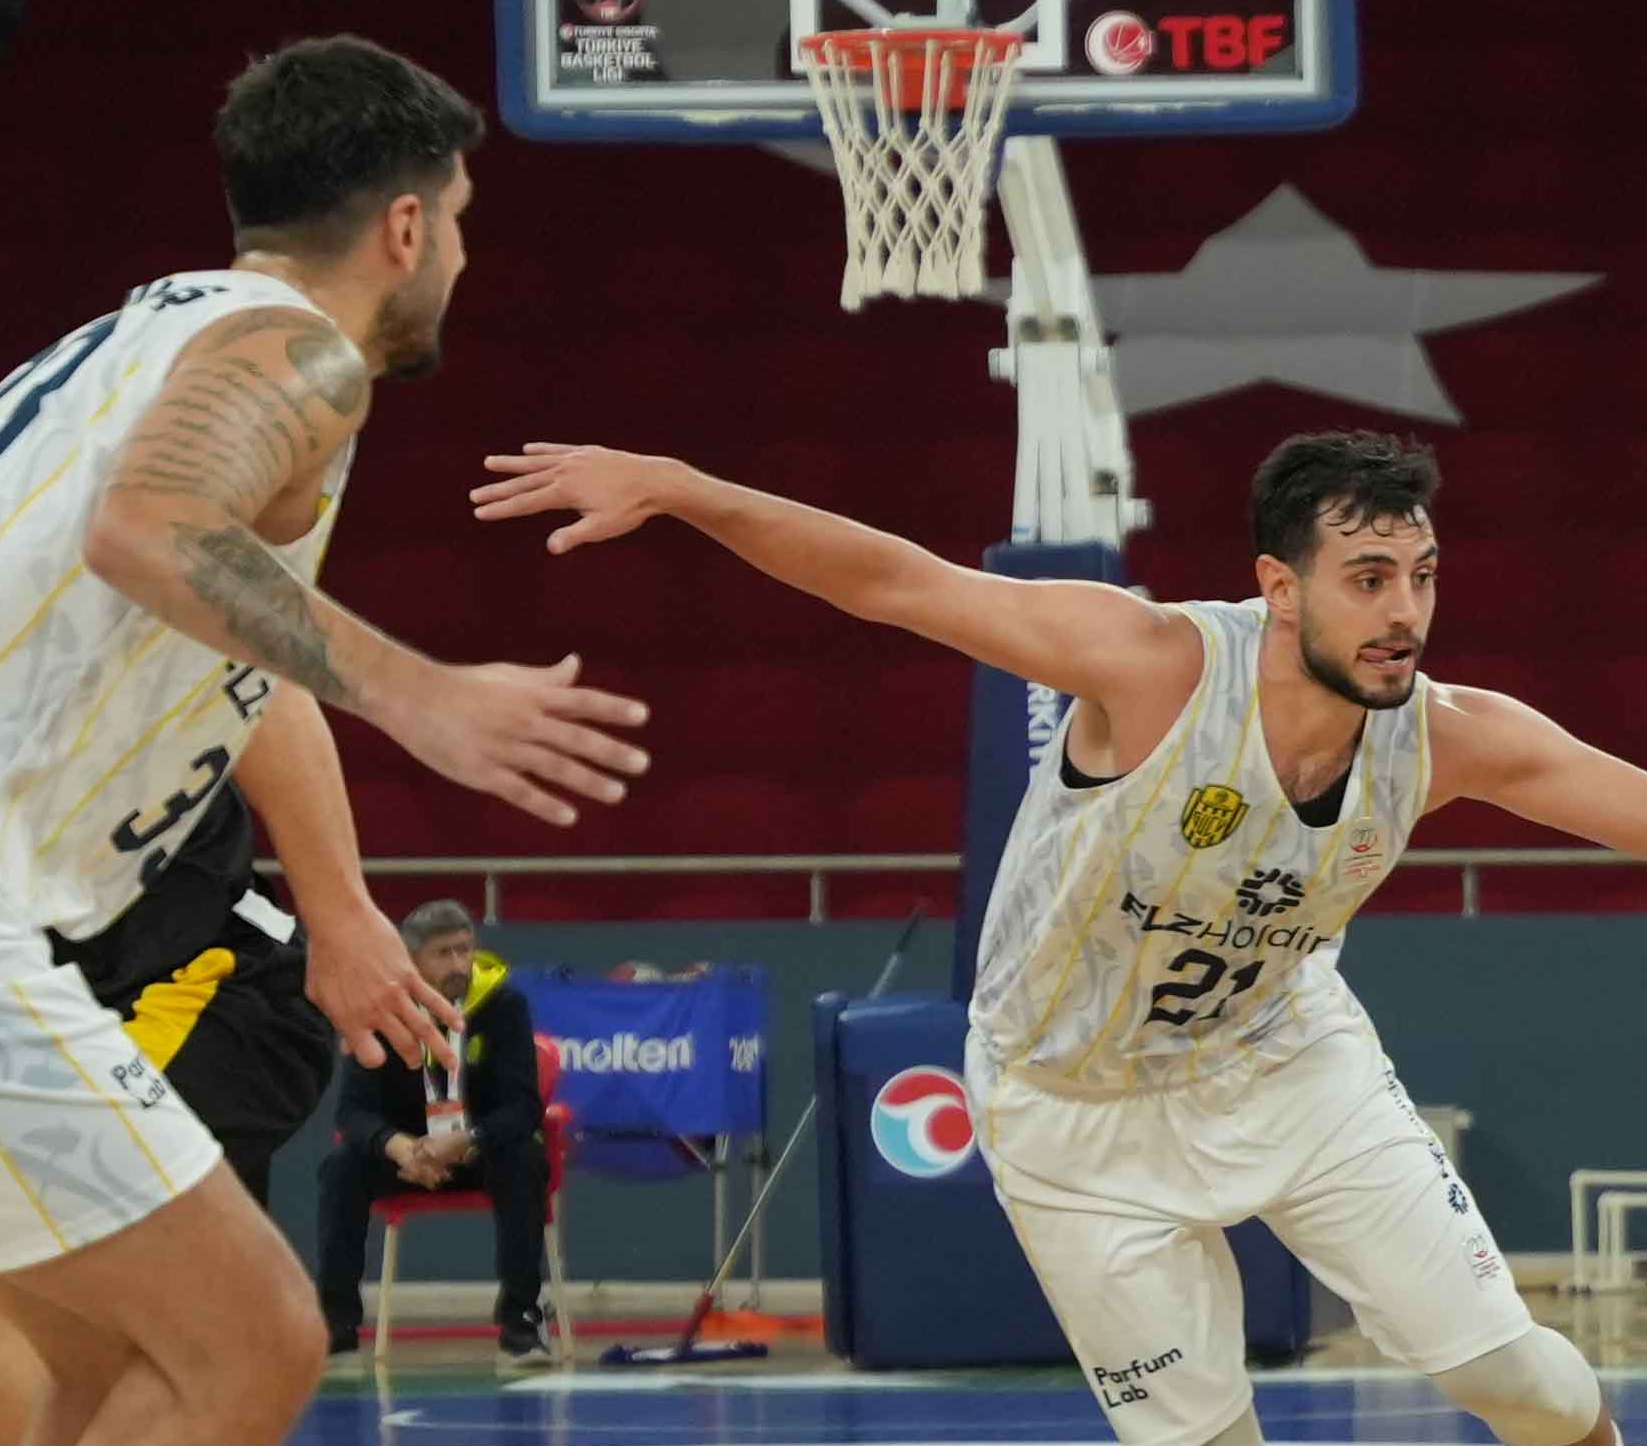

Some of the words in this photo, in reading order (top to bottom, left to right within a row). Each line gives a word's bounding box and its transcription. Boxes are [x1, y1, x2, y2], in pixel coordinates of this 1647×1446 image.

[1157, 14, 1287, 70] TBF
[1141, 947, 1266, 1028] 21
[1094, 1347, 1183, 1388] Parfum
[1103, 1383, 1149, 1410] Lab
